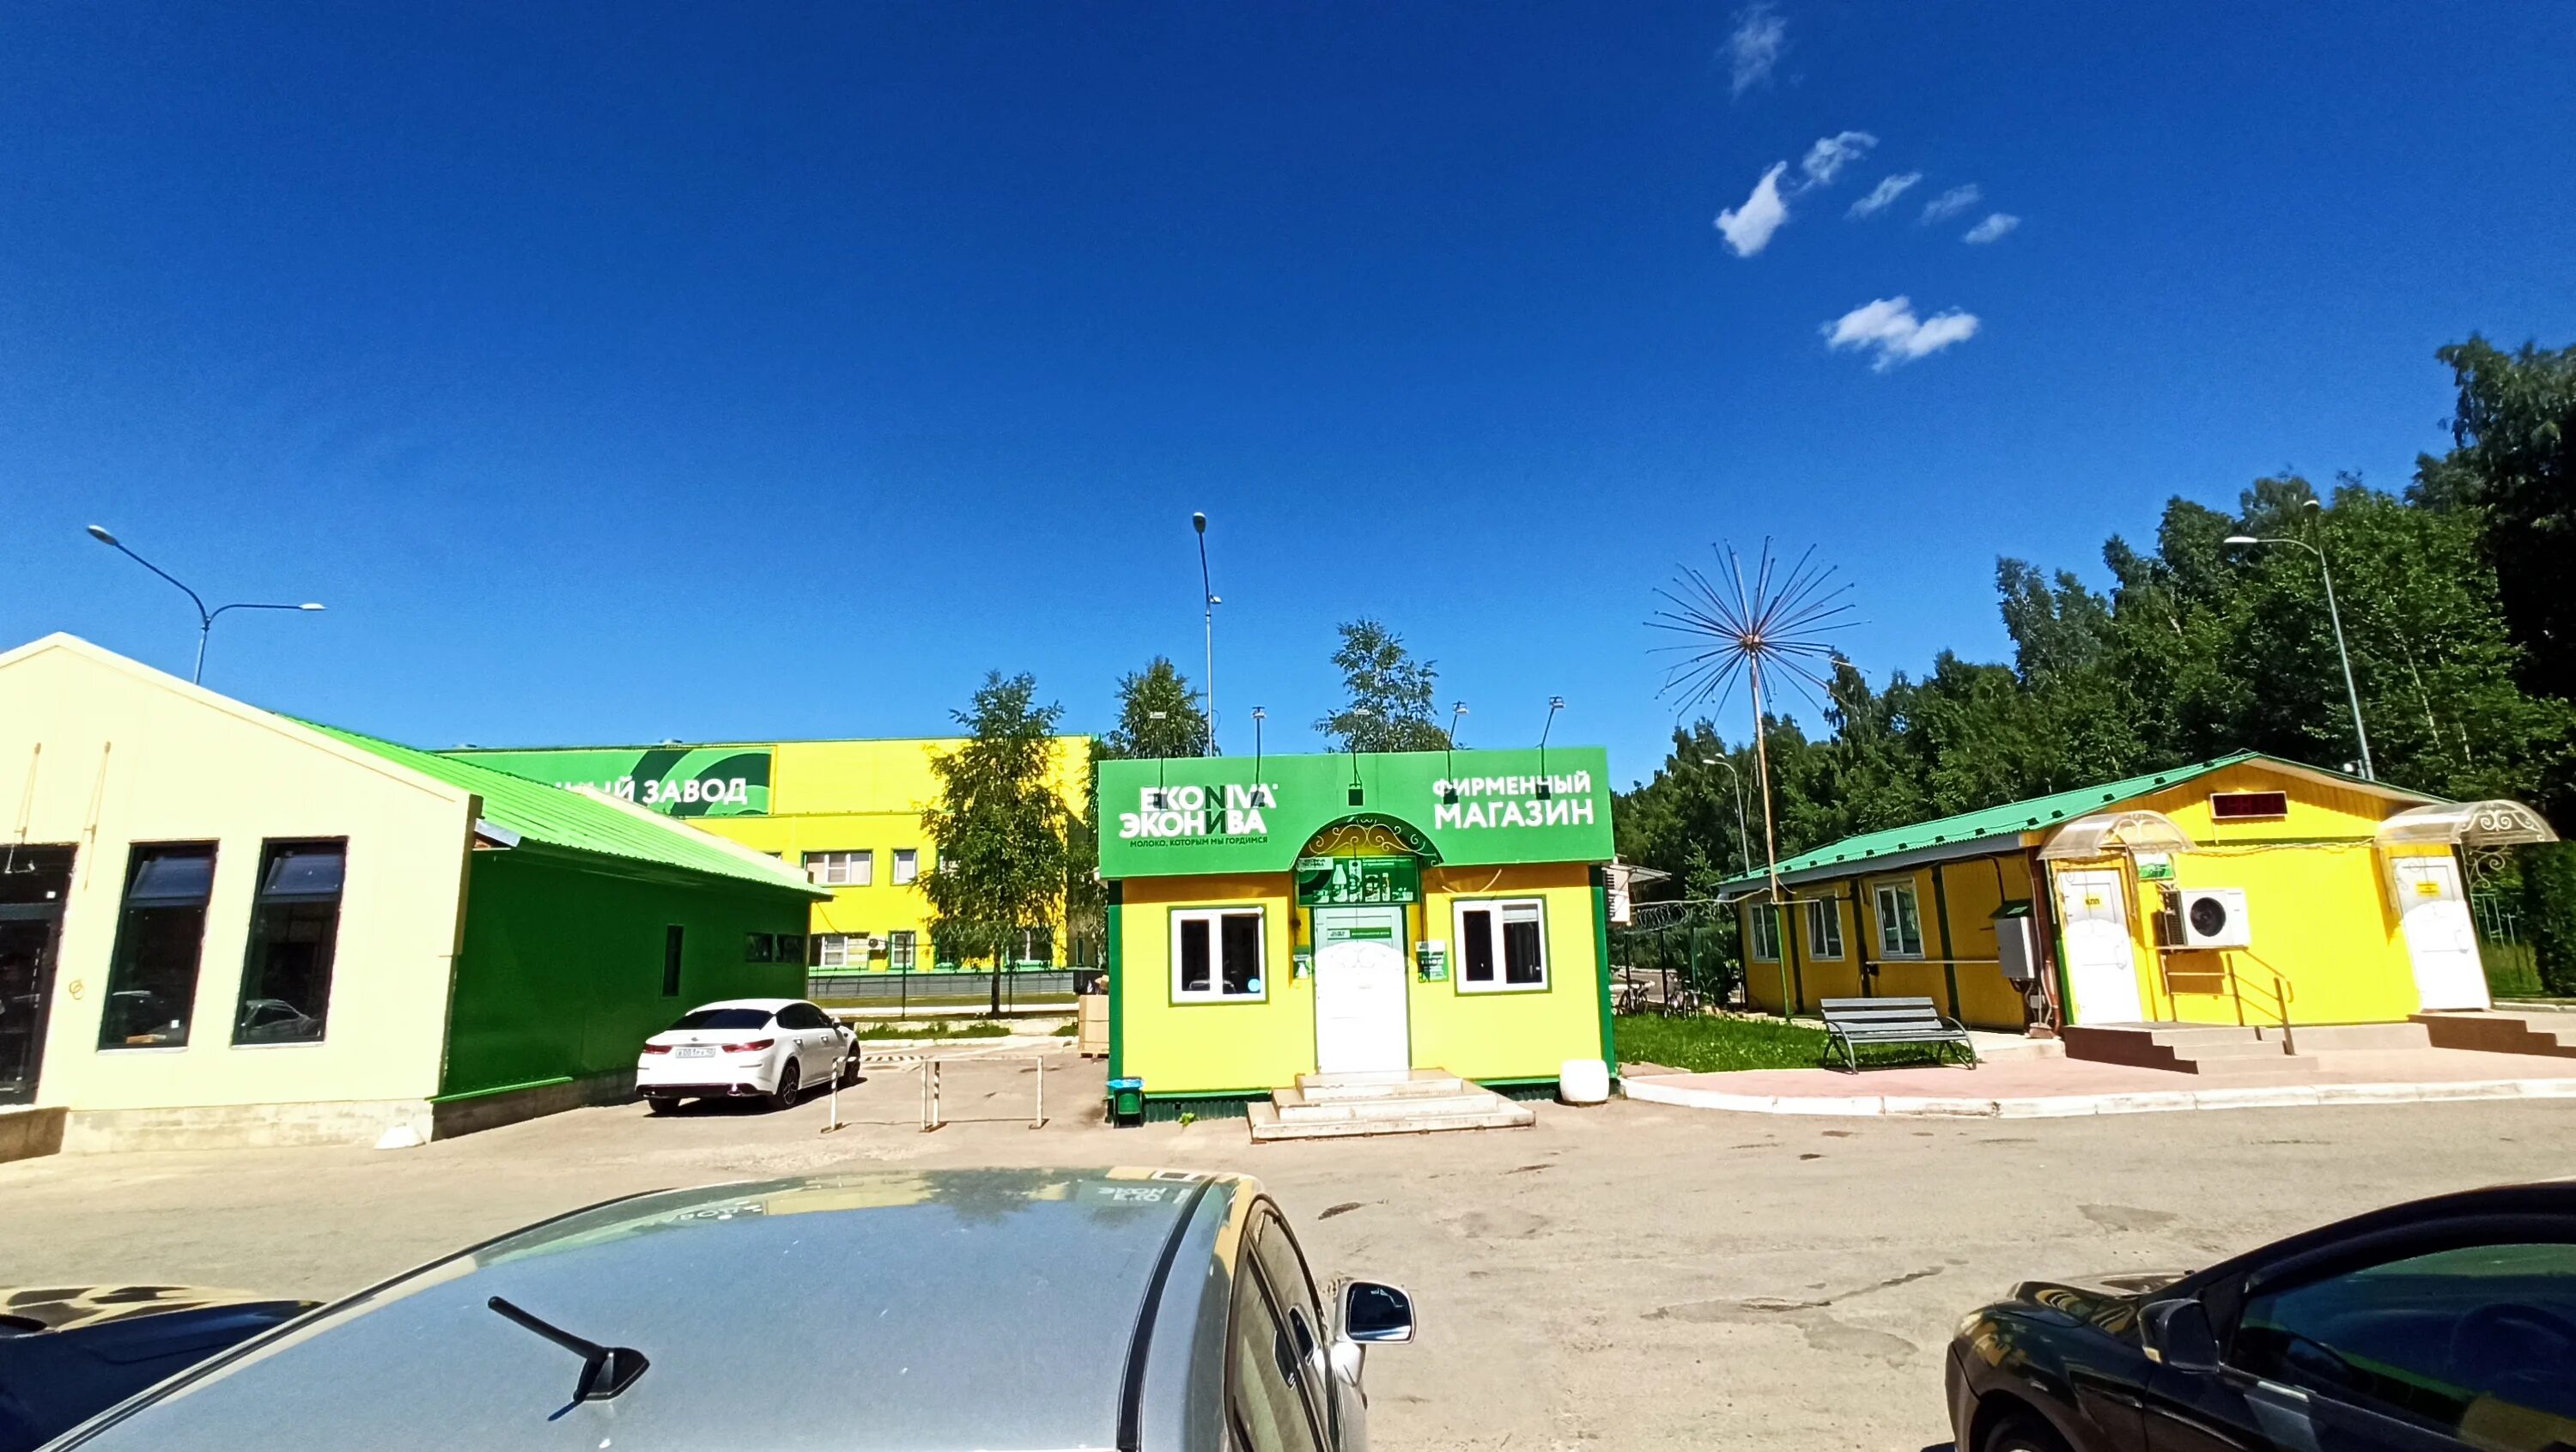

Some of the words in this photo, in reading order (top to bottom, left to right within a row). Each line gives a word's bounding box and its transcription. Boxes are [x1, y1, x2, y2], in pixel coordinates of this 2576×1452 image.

[642, 777, 747, 805] ЗАВОД
[1432, 770, 1591, 797] ФИРМЕННЫЙ
[1119, 809, 1267, 838] ЭКОНИВА
[1434, 799, 1594, 829] МАГАЗИН
[1170, 838, 1209, 847] КОТОРЫМ
[1225, 836, 1268, 845] ГОРДИМСЯ
